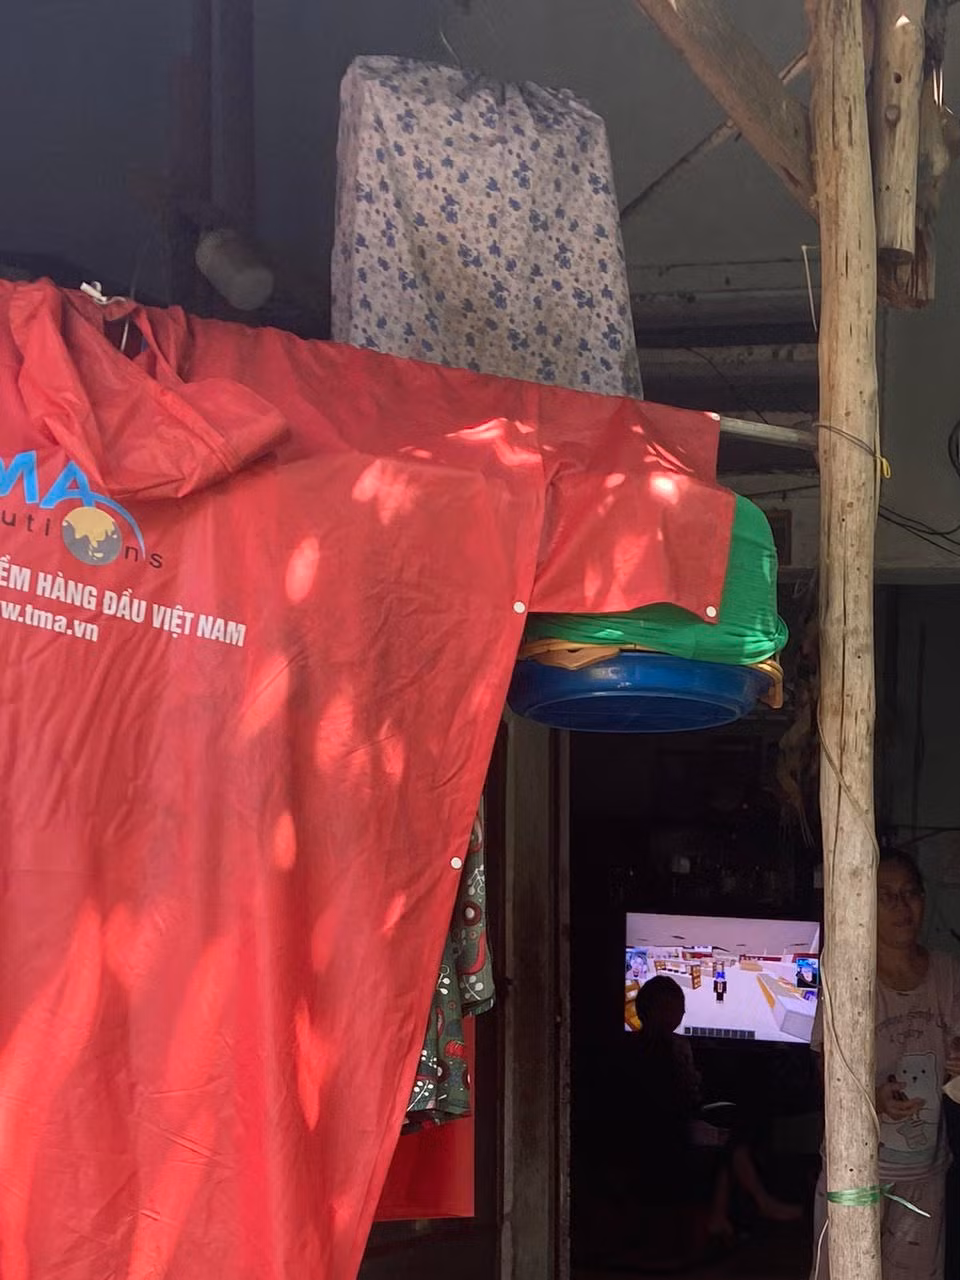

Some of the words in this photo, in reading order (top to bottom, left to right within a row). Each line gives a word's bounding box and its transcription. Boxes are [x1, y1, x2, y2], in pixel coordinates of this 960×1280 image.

[36, 571, 98, 610] HÀNG
[102, 588, 146, 623] ĐẦU
[152, 604, 194, 639] VIỆT
[196, 615, 246, 647] NAM
